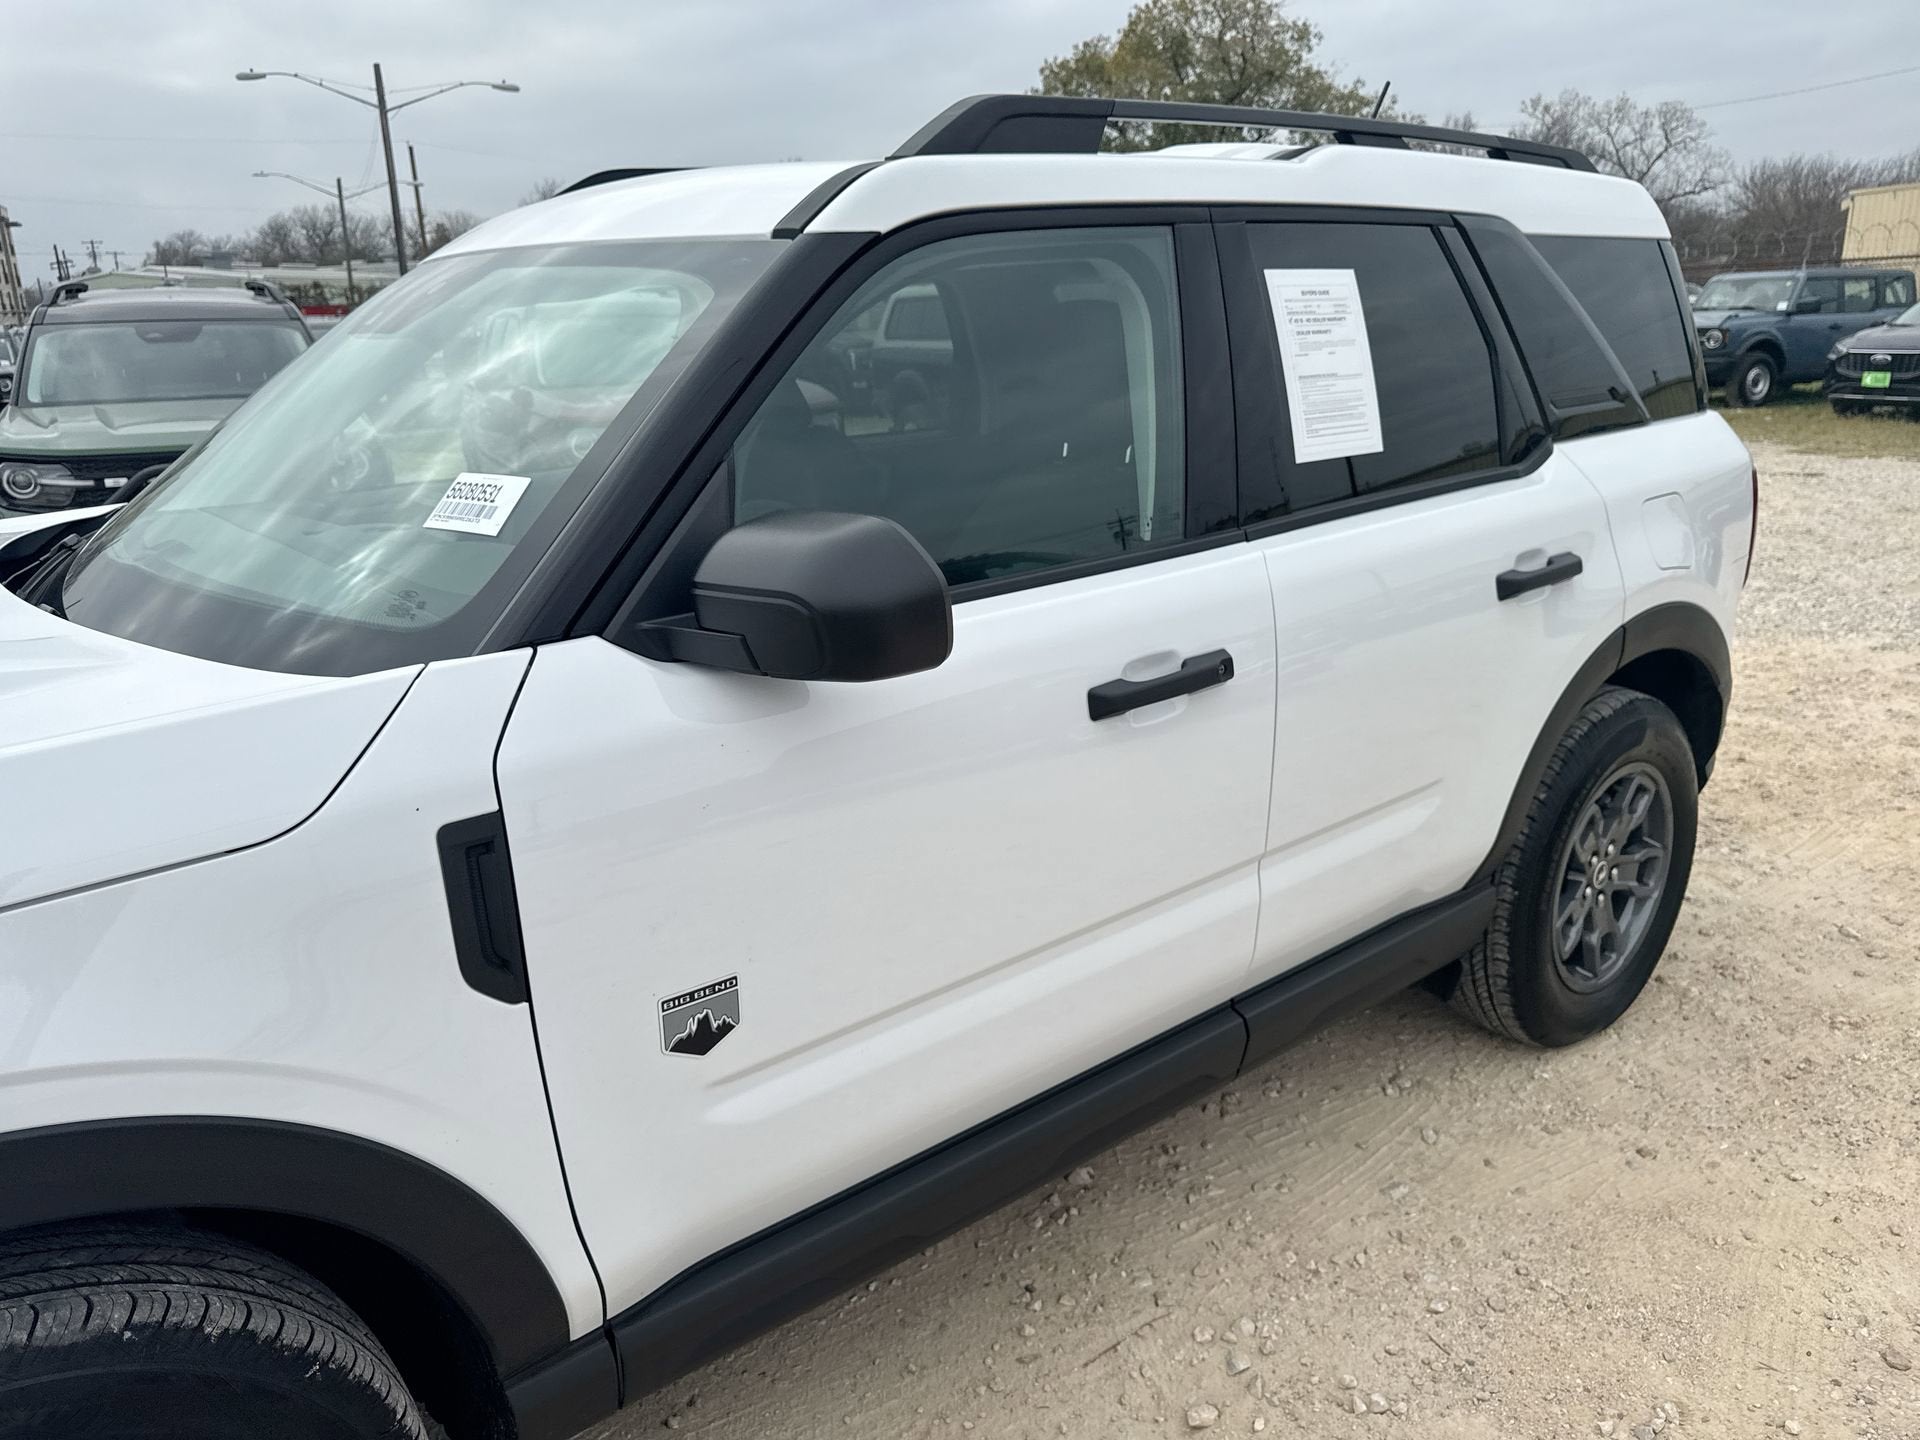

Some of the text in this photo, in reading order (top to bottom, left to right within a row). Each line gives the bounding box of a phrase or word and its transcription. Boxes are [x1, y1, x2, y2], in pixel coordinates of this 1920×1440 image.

[446, 482, 504, 503] 56080531
[663, 979, 736, 1010] BIG BEND
